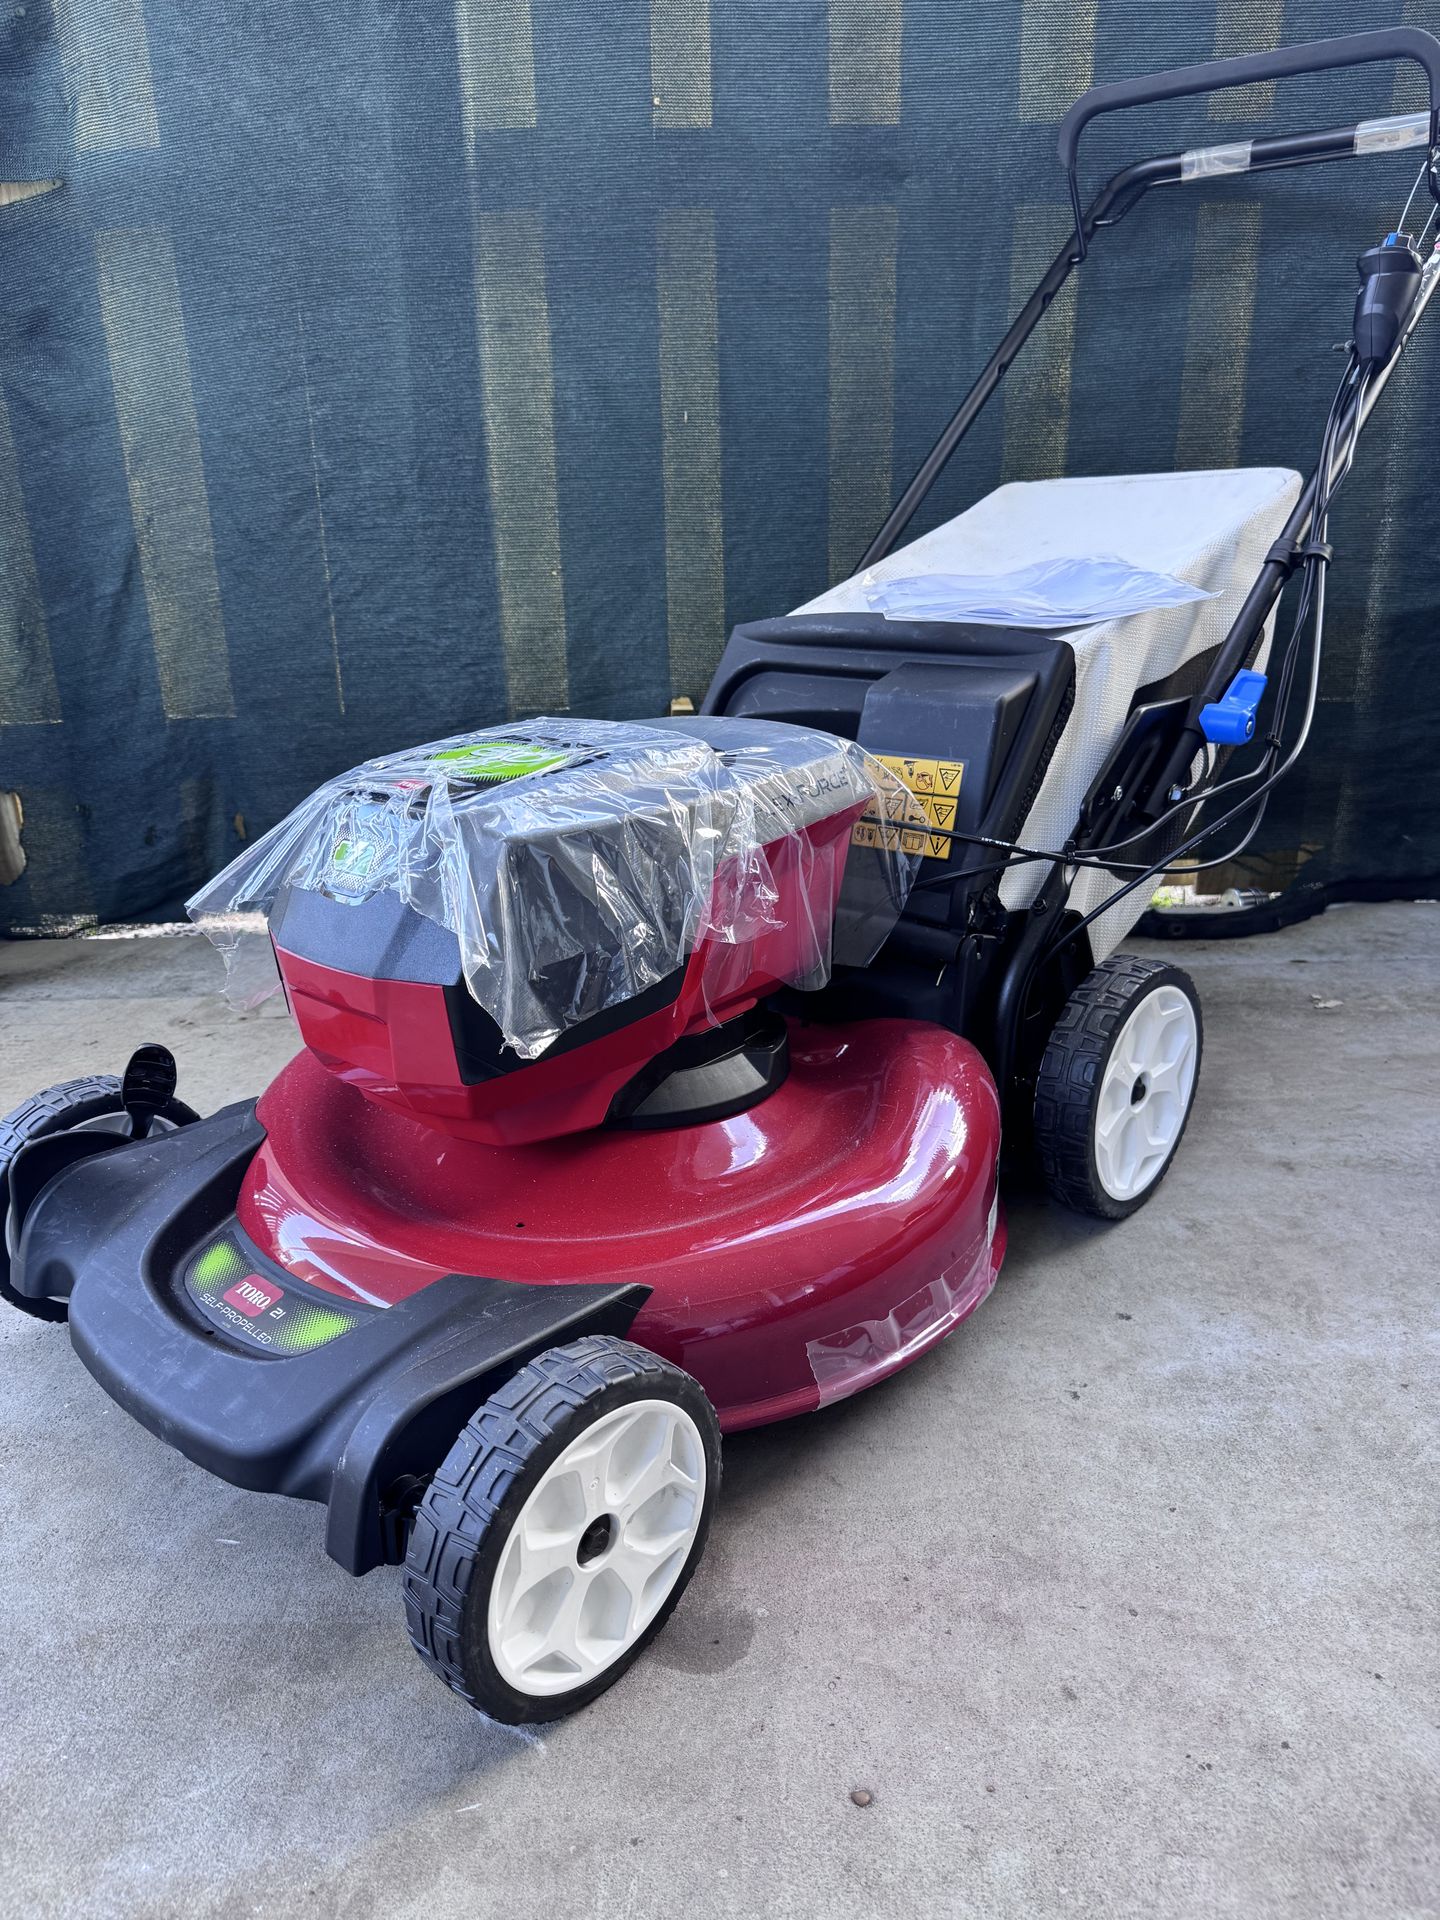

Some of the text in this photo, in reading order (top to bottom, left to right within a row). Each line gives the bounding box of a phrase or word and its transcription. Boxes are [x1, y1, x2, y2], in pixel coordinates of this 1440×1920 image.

[235, 1281, 271, 1308] TORO
[199, 1293, 272, 1345] SELF-PROPELLED
[269, 1307, 286, 1320] 21
